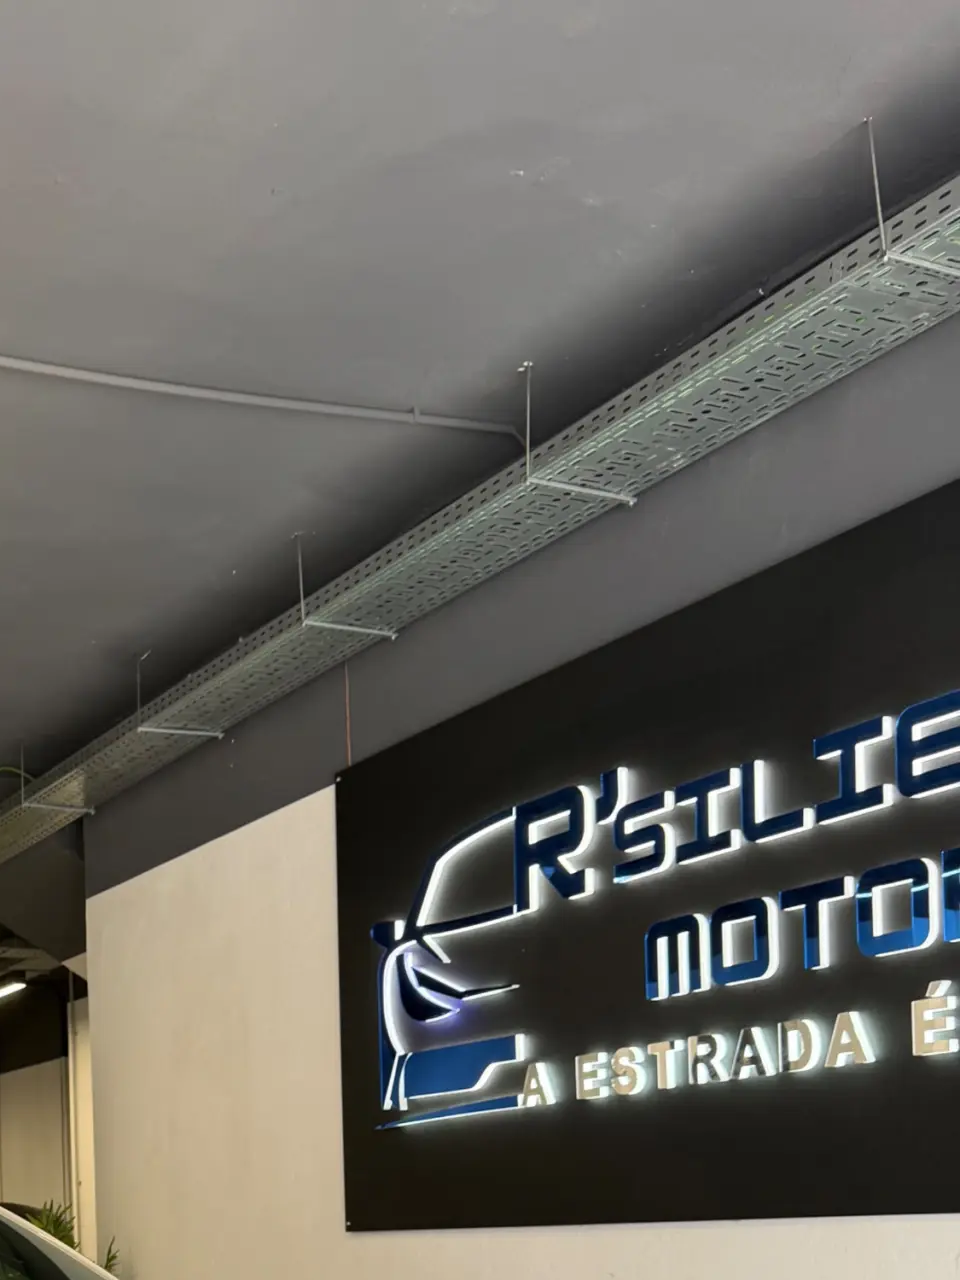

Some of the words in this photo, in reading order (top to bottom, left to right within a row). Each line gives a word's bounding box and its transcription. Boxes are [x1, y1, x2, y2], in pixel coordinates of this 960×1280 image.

[644, 848, 960, 1000] MOTO
[521, 1062, 556, 1107] A
[575, 1010, 876, 1100] ESTRADA
[911, 979, 960, 1057] É
